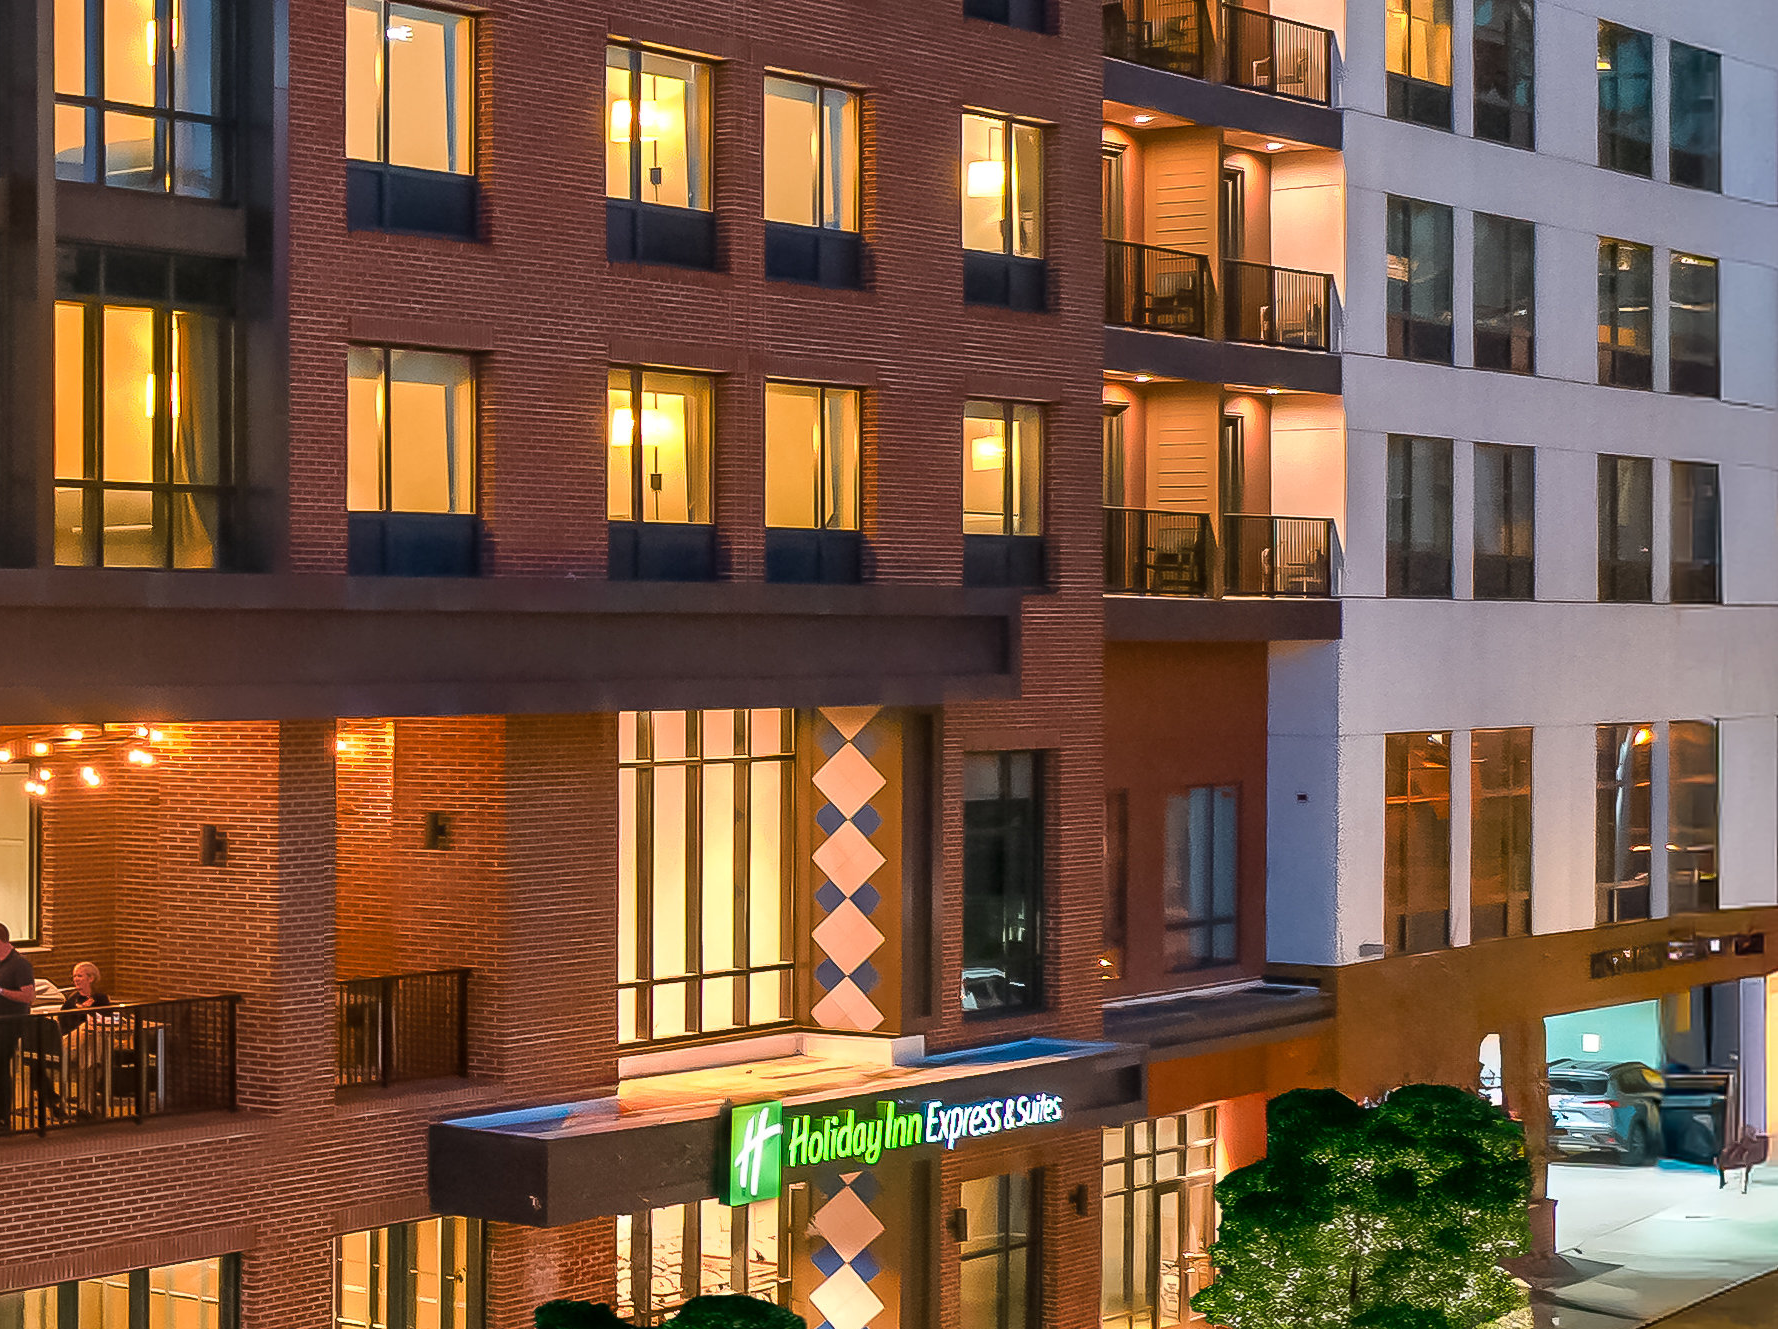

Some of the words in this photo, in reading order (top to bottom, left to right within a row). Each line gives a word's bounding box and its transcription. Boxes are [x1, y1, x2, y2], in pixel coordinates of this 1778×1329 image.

[788, 1109, 883, 1167] Holiday
[883, 1100, 923, 1149] Inn
[923, 1099, 1004, 1151] Express
[1002, 1098, 1017, 1130] &
[1016, 1093, 1062, 1126] Suites
